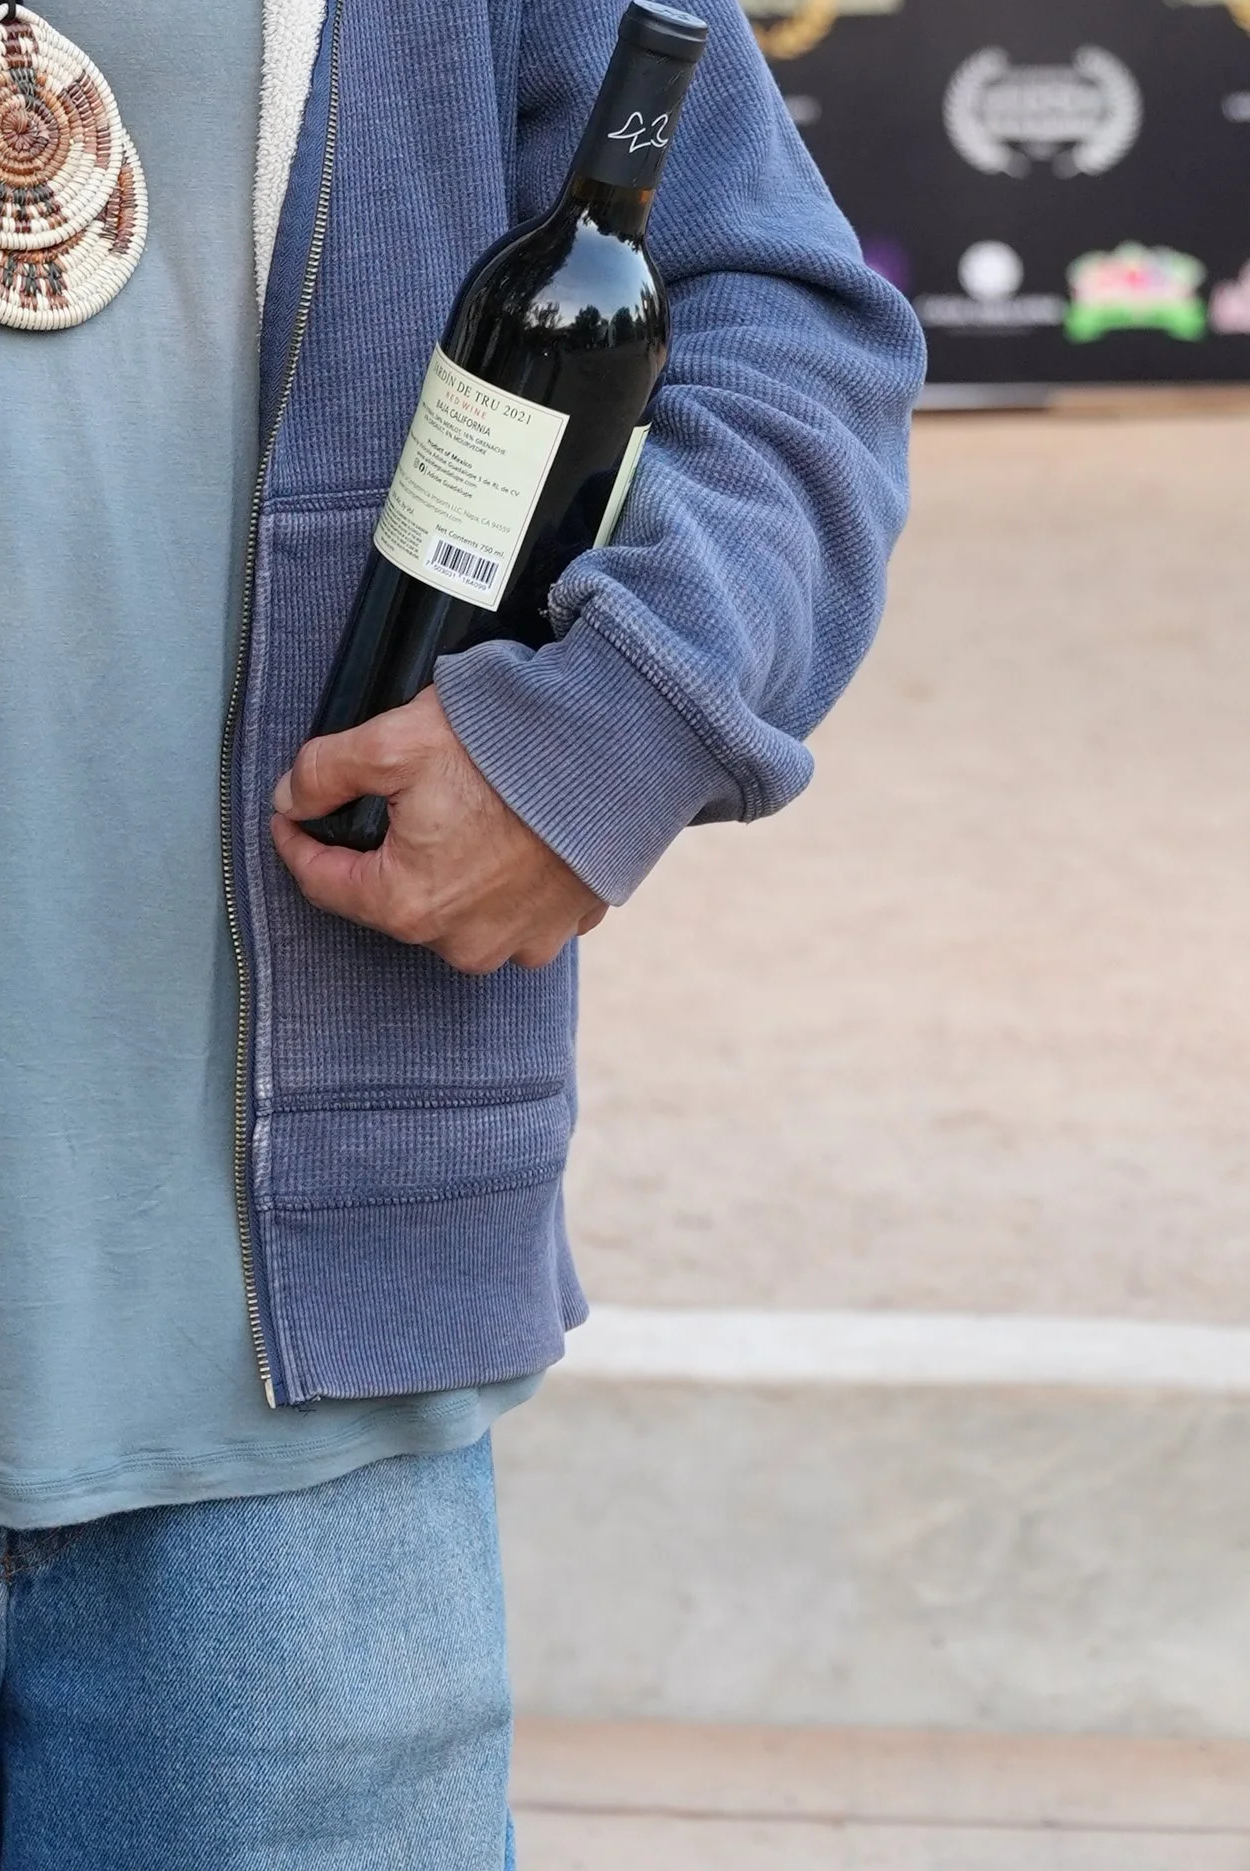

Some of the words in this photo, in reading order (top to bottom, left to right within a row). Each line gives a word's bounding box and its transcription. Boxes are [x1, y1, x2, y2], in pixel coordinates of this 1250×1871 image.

[434, 360, 457, 387] JARDÍN
[457, 381, 472, 398] DE
[476, 390, 501, 411] TRU
[503, 405, 532, 425] 2021
[446, 391, 460, 404] RED
[462, 401, 487, 420] WINE
[436, 399, 449, 414] BAJA
[449, 409, 491, 436] CALIFORNIA
[427, 438, 444, 454] Product
[451, 453, 473, 469] Mexico
[442, 478, 473, 499] Guadalupe
[447, 461, 477, 481] Guadalupe
[510, 489, 520, 497] CV
[480, 516, 491, 527] CA
[435, 523, 448, 535] Net
[448, 530, 479, 548] Contents
[479, 543, 493, 555] 750
